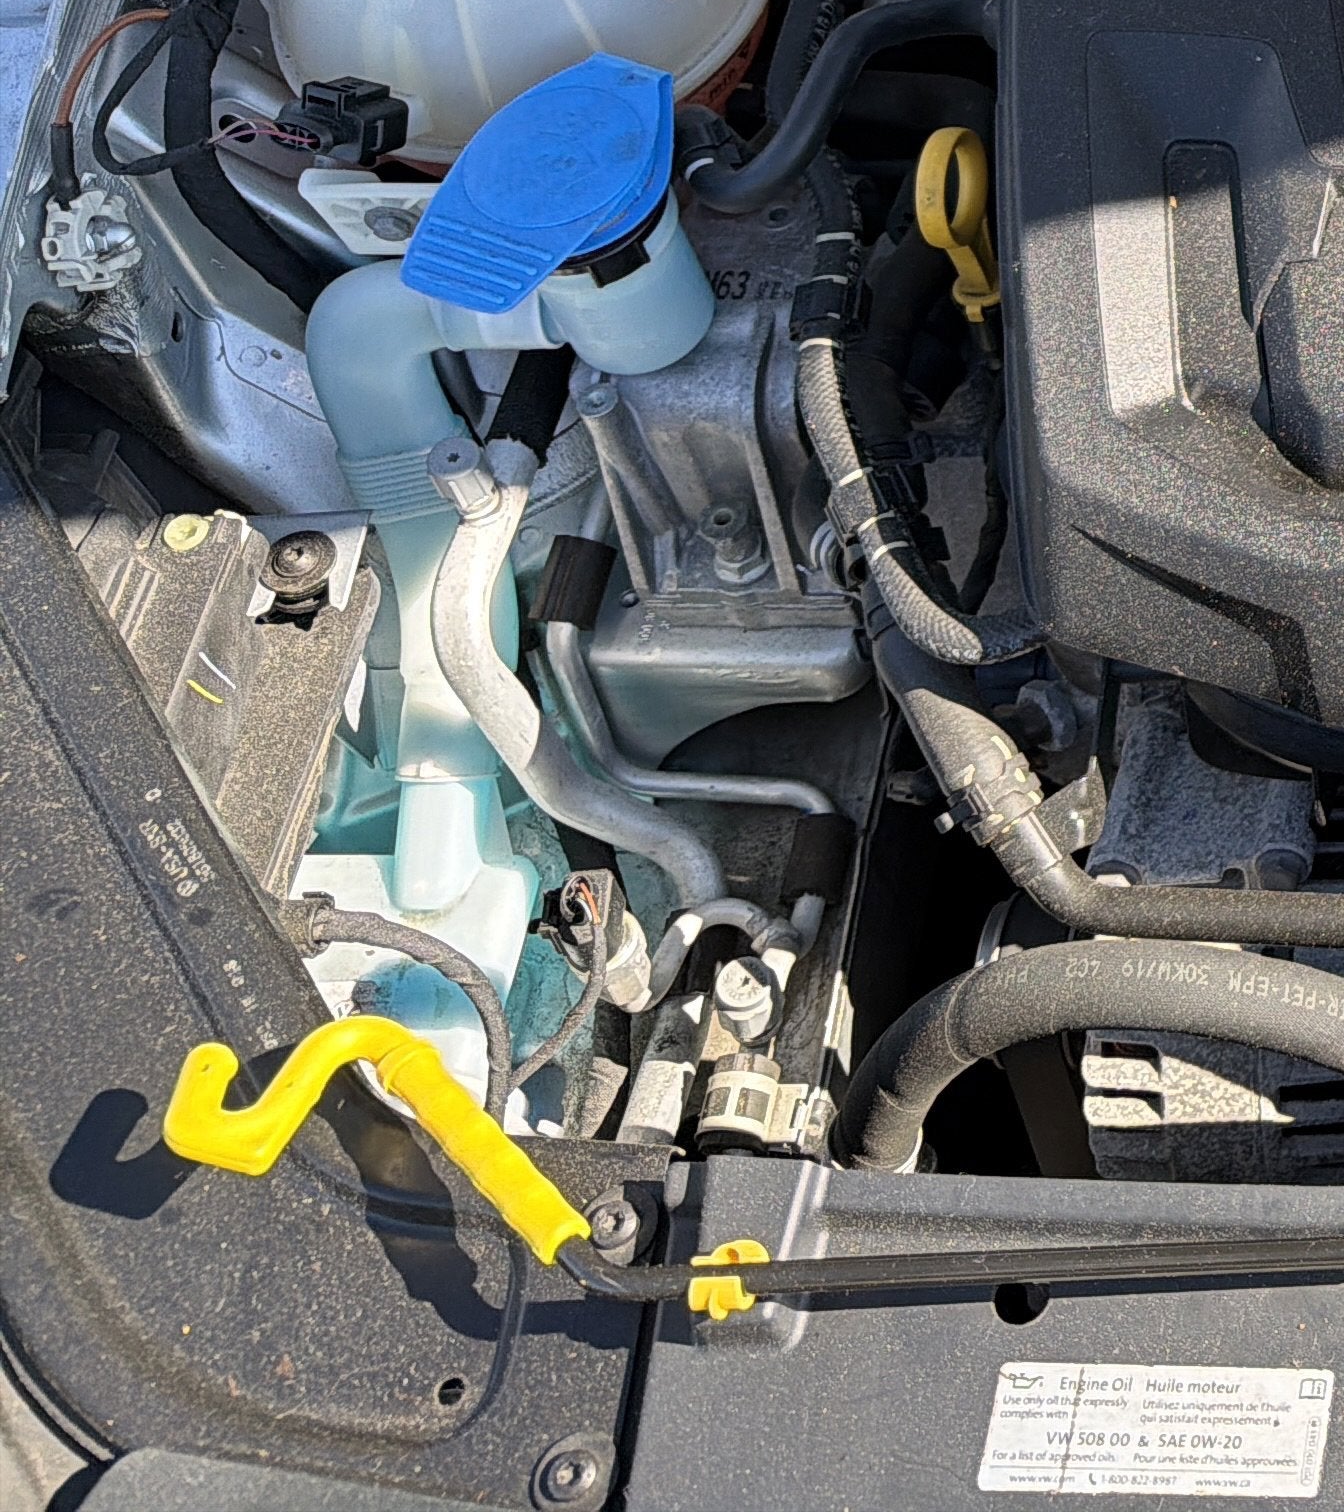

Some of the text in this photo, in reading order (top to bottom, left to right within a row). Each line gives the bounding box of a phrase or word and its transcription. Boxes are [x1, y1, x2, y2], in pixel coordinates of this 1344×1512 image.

[1060, 1377, 1133, 1394] Engine Oil
[1145, 1378, 1241, 1394] Huile moteur
[1002, 1395, 1022, 1405] Use
[1023, 1395, 1045, 1408] only
[1083, 1396, 1128, 1408] expressly
[1182, 1401, 1243, 1415] uniquement
[1000, 1409, 1069, 1420] complies with
[1159, 1413, 1199, 1424] satisfait
[1046, 1431, 1242, 1449] VW 508 00 & SAE 0W-20
[992, 1450, 1008, 1460] For
[1018, 1450, 1033, 1460] list
[1035, 1450, 1048, 1461] of
